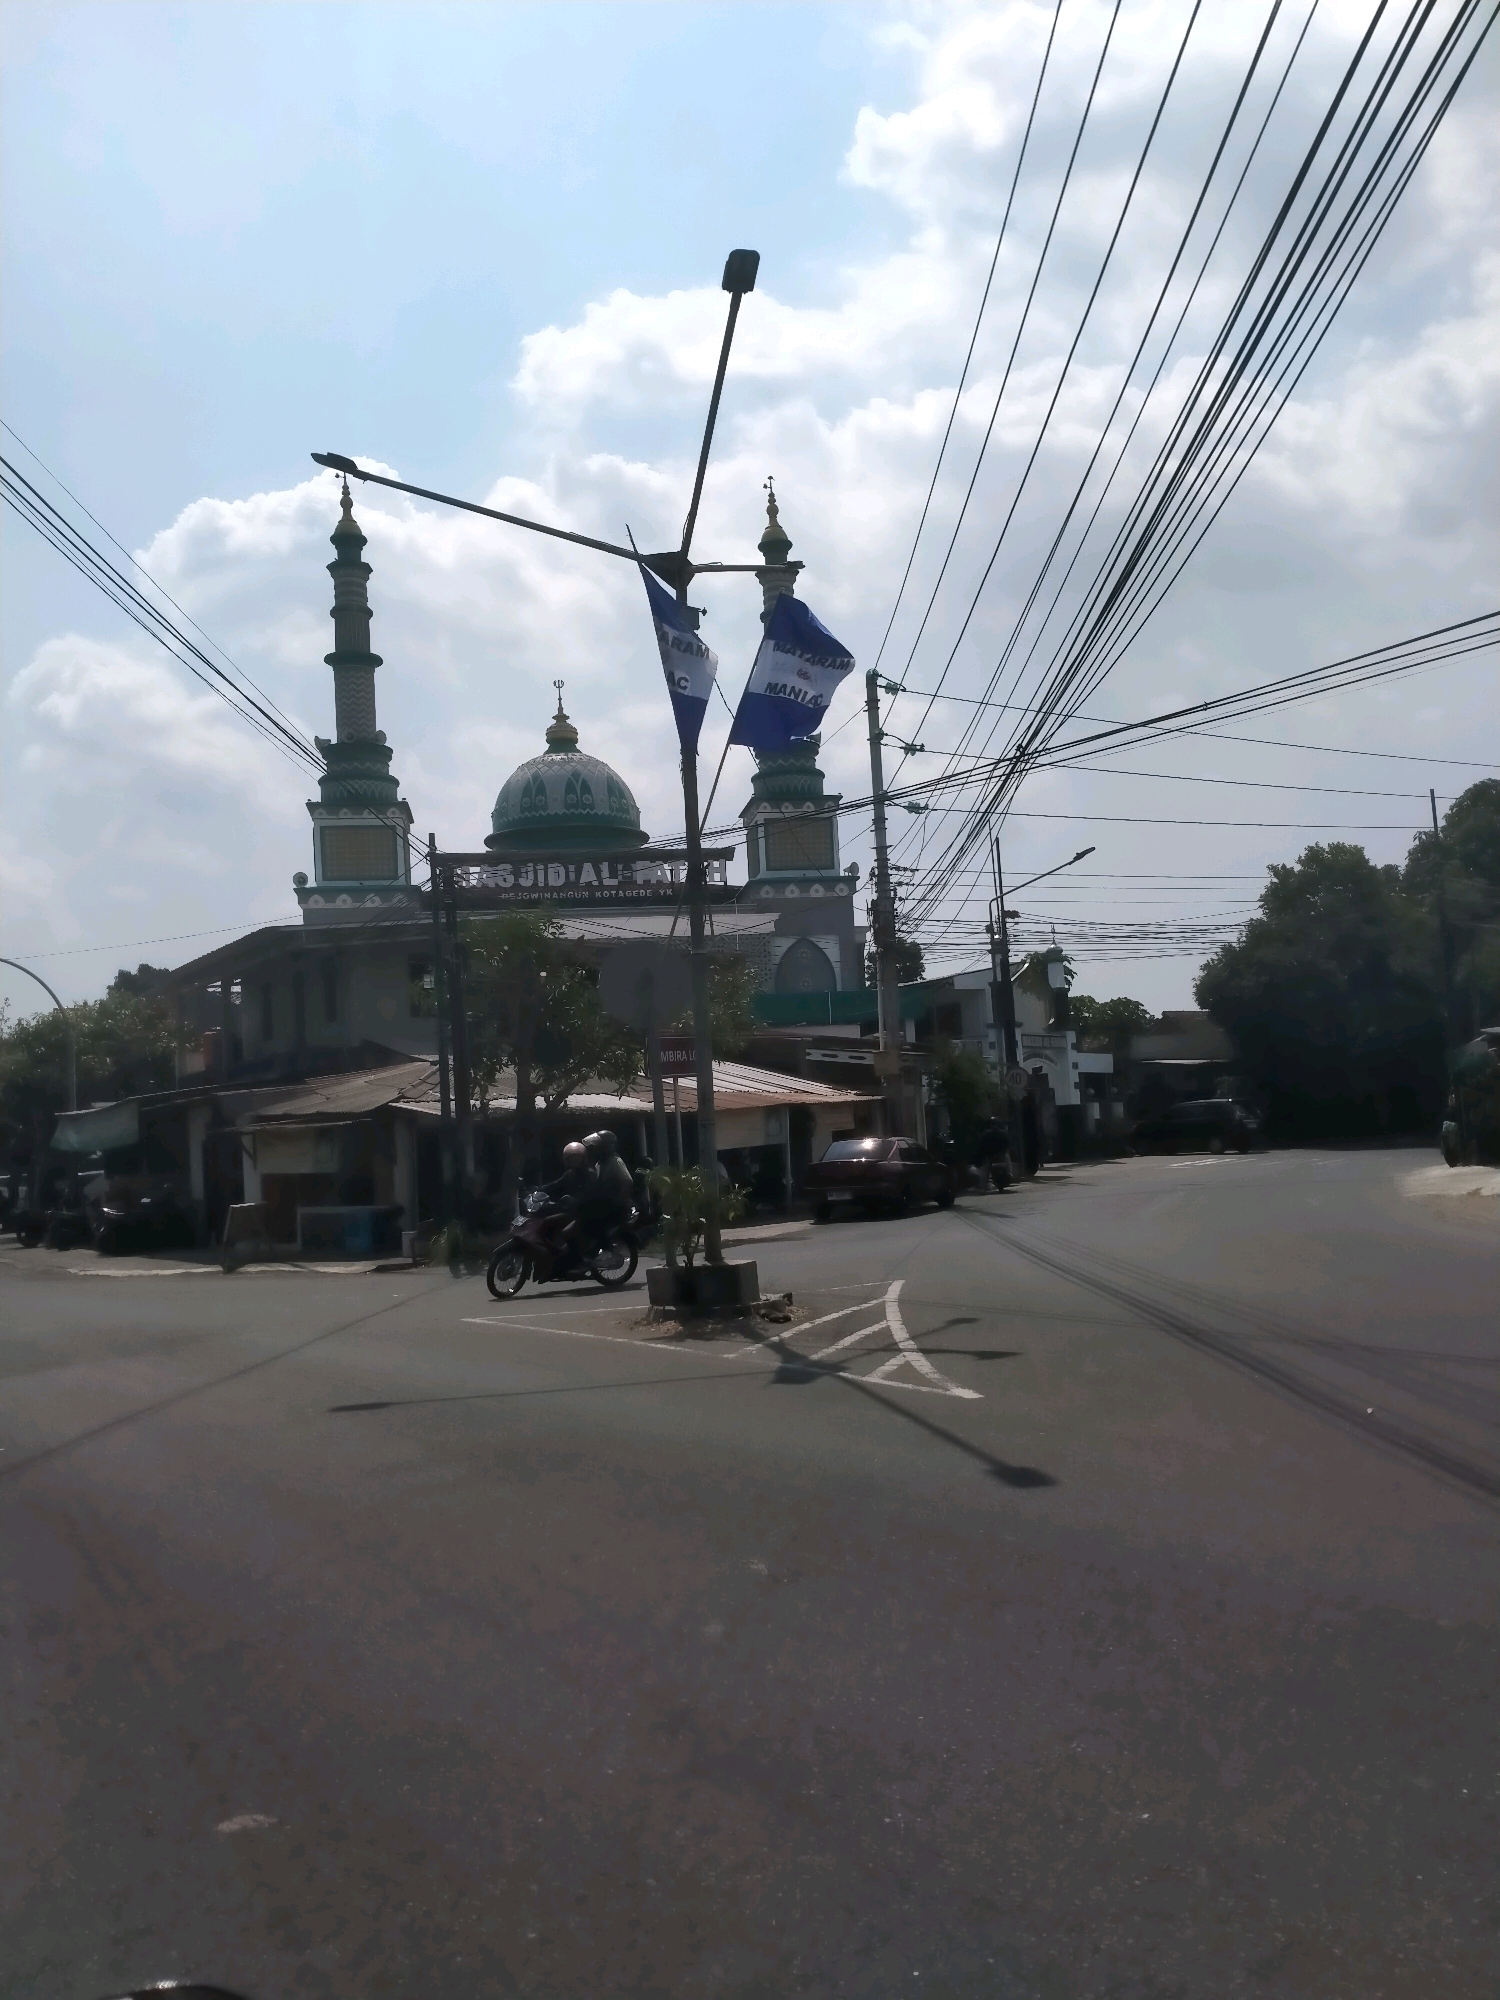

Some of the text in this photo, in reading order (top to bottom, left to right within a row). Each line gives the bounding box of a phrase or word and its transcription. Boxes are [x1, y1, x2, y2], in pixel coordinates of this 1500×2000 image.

[773, 641, 851, 671] MATARAM
[764, 682, 823, 707] MANIAC
[636, 859, 727, 885] FATH
[595, 889, 653, 898] KOTAGEDE
[659, 888, 673, 896] YK
[660, 1050, 687, 1062] MBIRA
[1009, 1072, 1022, 1085] 40
